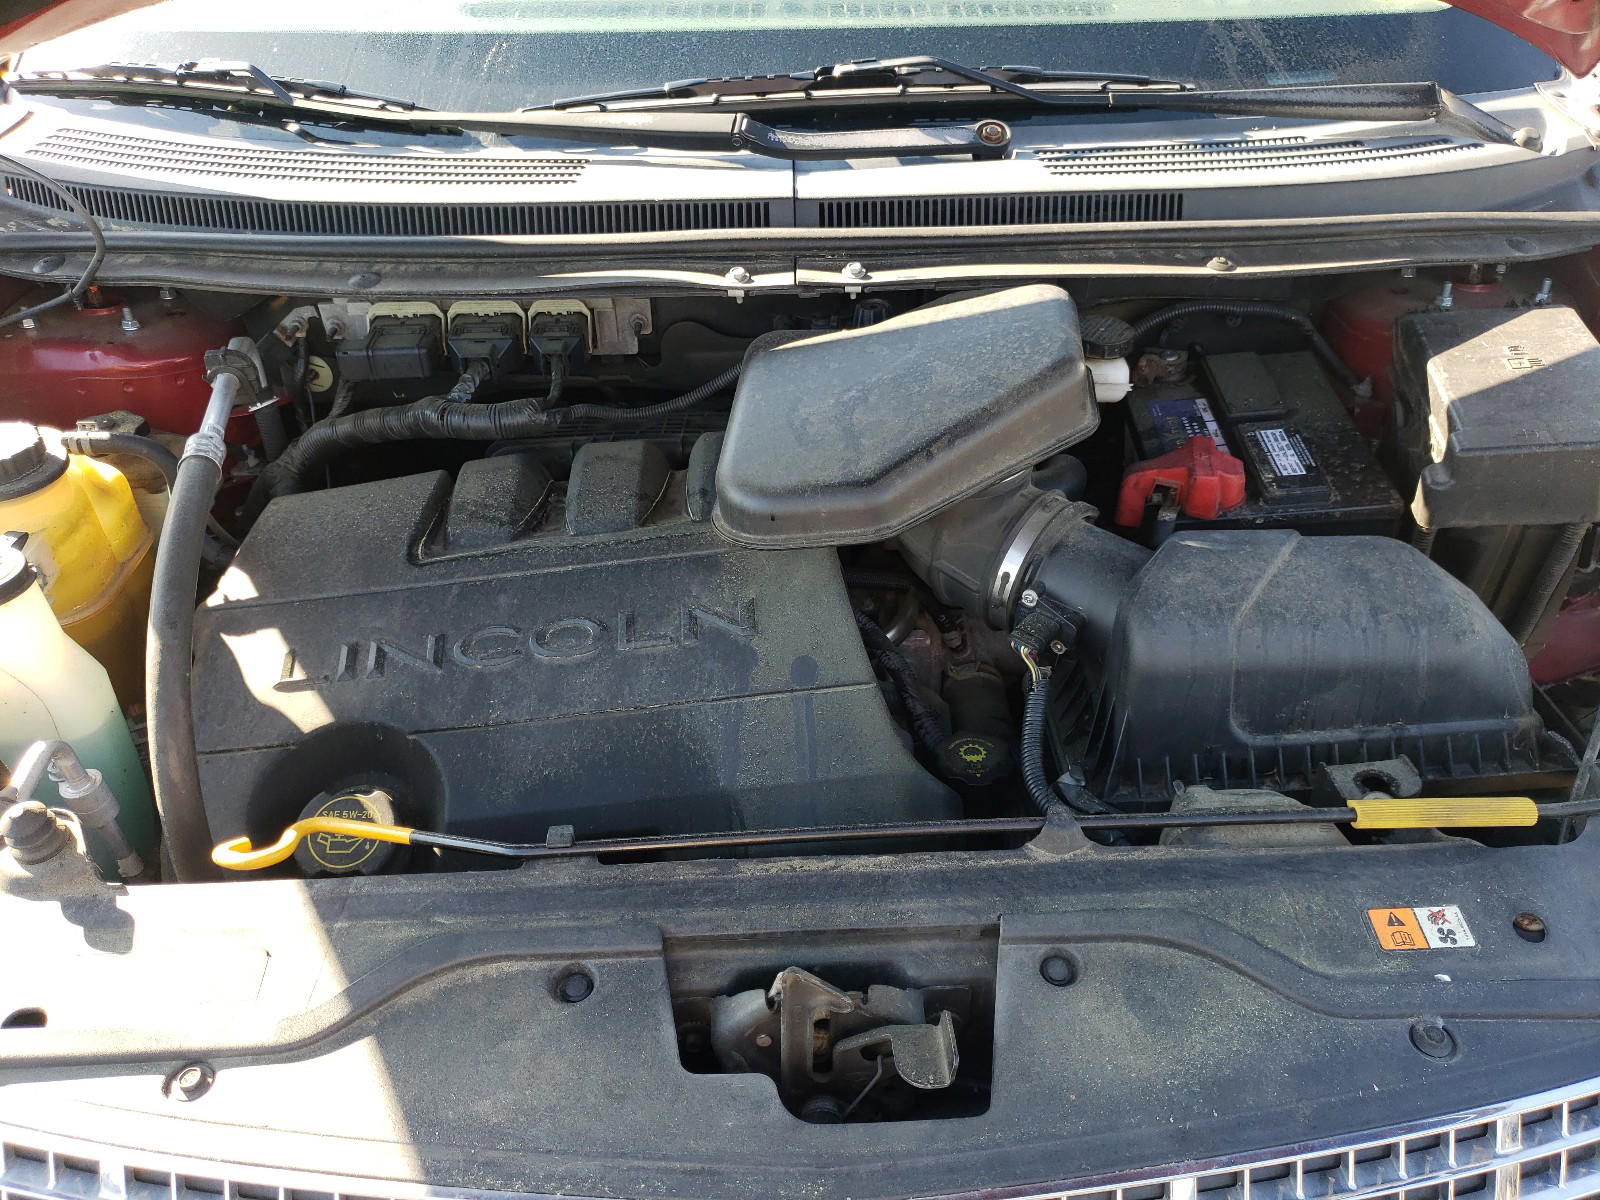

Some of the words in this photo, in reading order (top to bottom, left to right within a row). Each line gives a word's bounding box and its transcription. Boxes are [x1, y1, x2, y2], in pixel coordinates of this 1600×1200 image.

[273, 597, 757, 692] LINCOLN
[322, 810, 340, 818] SAE
[342, 810, 374, 819] 5W-20
